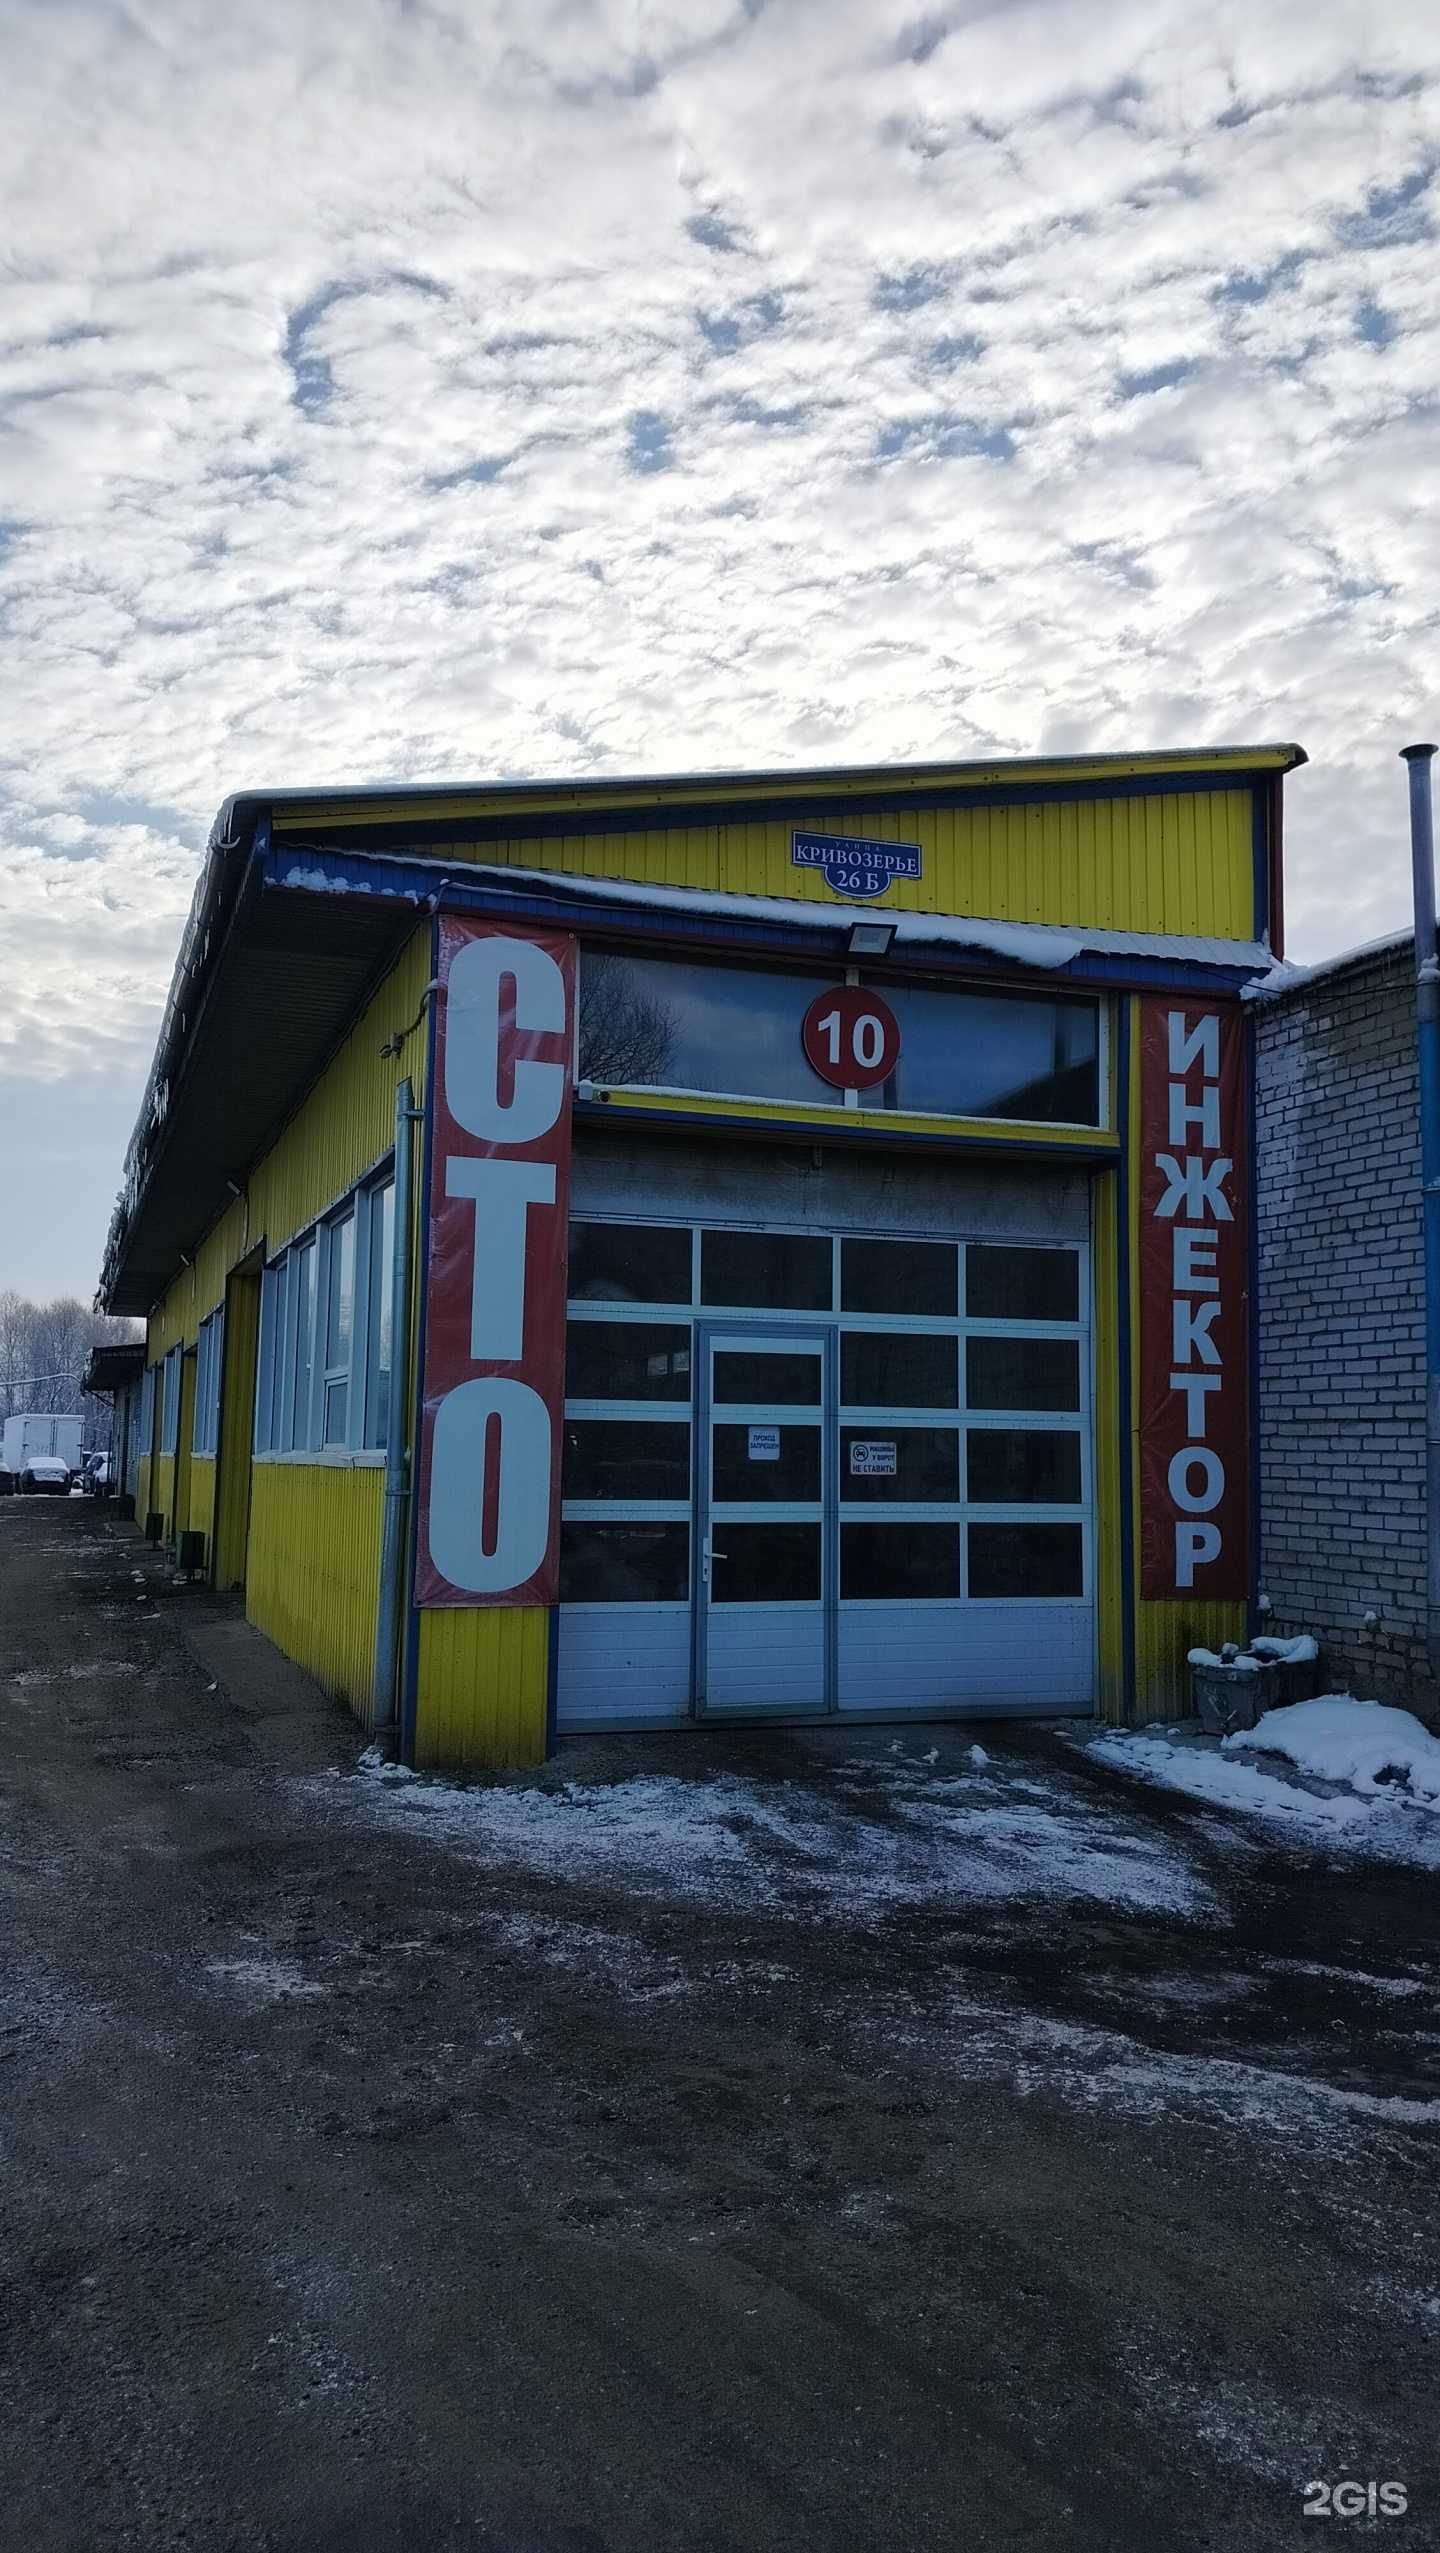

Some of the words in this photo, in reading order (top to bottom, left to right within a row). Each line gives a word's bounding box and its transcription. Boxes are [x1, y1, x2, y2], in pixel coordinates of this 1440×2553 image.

[796, 845, 918, 873] КРИВОЗЕРЬЕ
[833, 841, 880, 852] УЛИЦА
[837, 870, 860, 888] 26
[865, 872, 879, 890] Б
[818, 1010, 885, 1068] 10
[428, 936, 565, 1593] СТО
[1153, 1011, 1235, 1588] ИНЖЕКТОР
[852, 1464, 862, 1472] НЕ
[863, 1464, 895, 1473] СТАВИТЬ
